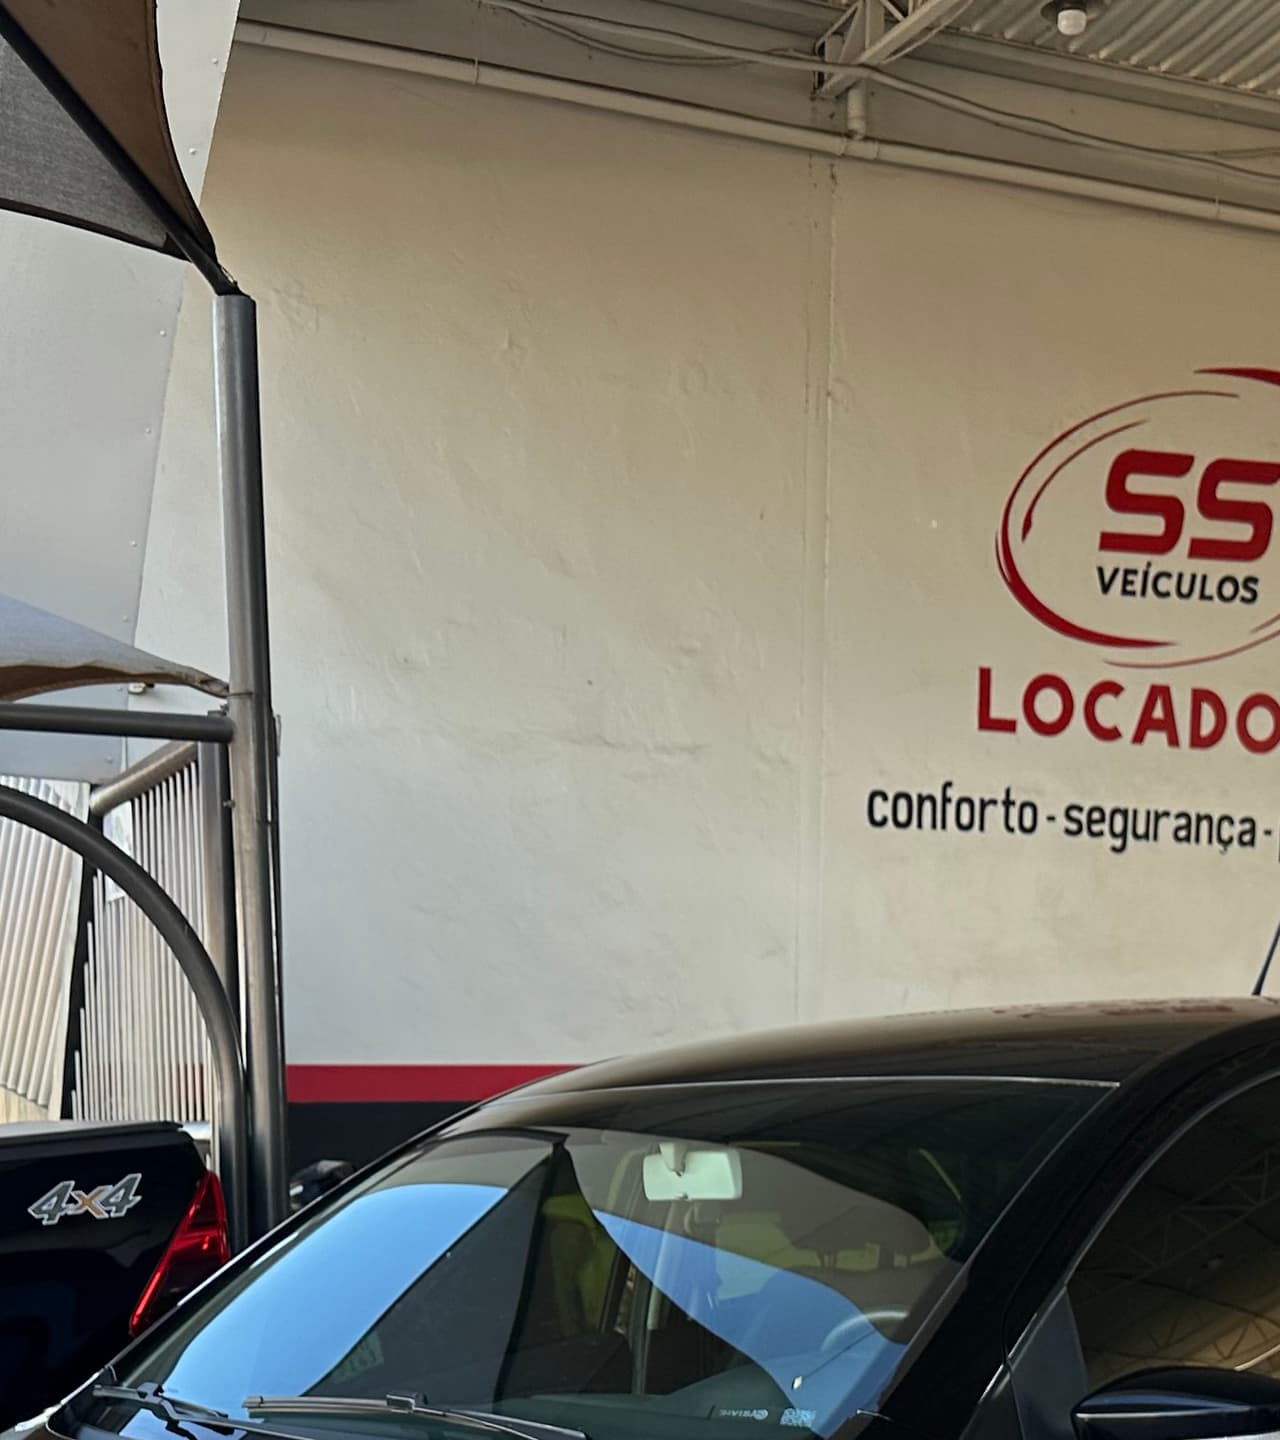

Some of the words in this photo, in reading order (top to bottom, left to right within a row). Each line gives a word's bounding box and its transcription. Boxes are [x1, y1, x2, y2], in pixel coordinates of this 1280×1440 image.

[1097, 562, 1259, 604] VEÍCULOS
[866, 781, 1038, 836] conforto
[1063, 799, 1256, 853] segurança
